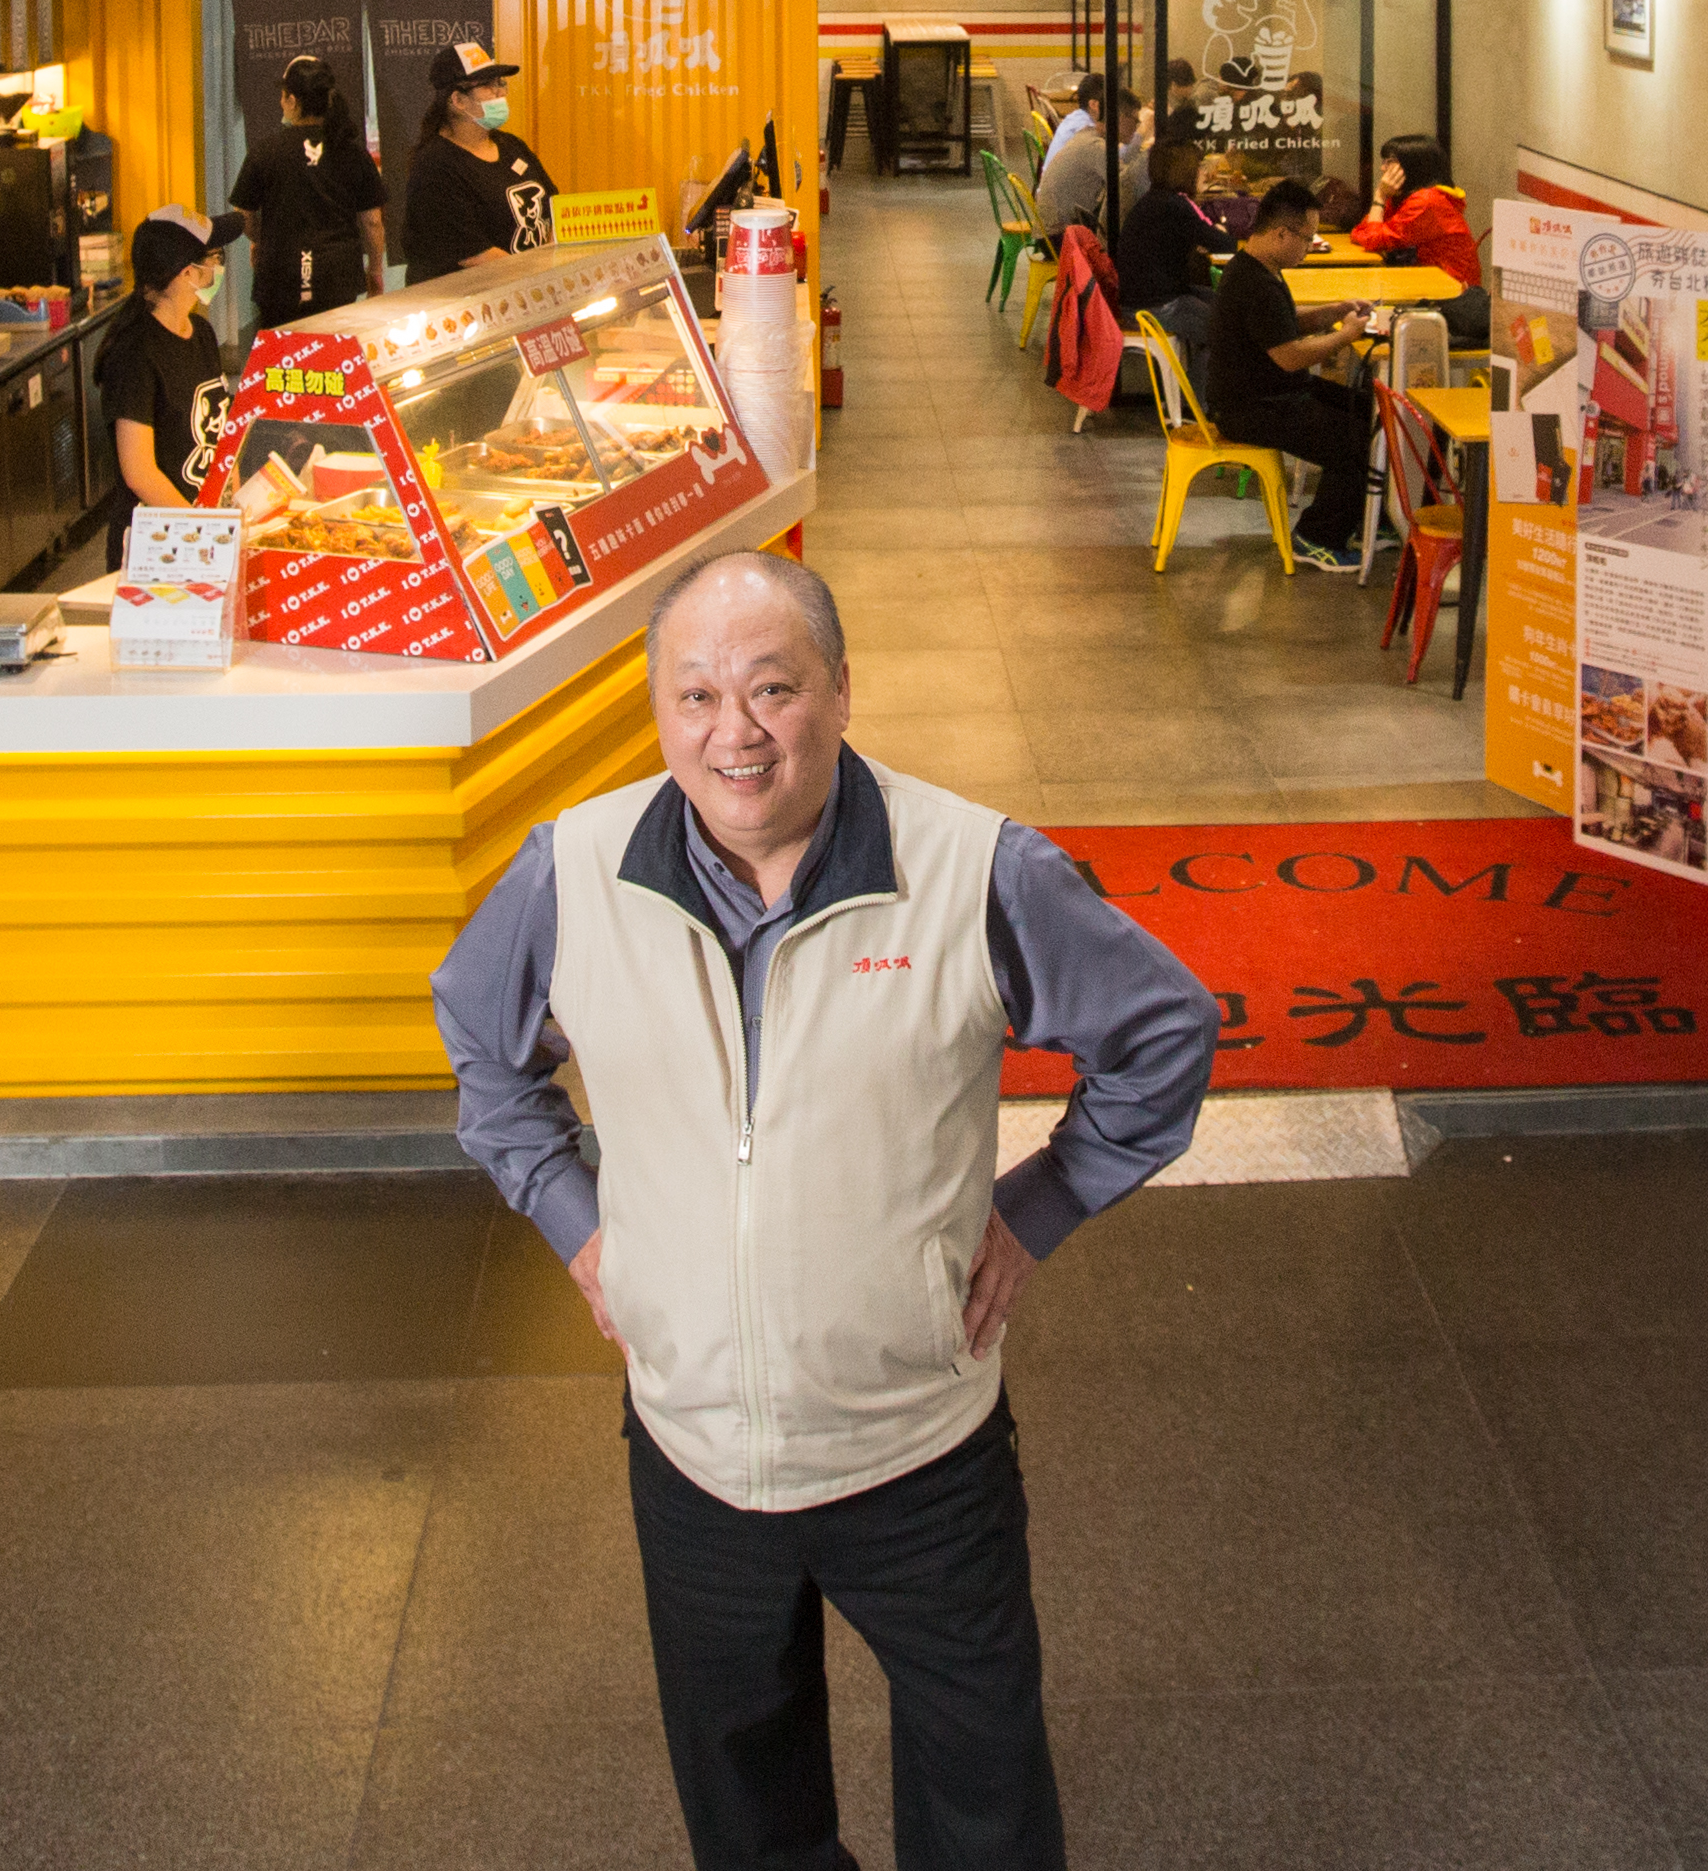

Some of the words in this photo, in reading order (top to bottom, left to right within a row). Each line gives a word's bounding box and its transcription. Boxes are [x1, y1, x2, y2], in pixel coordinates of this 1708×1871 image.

[593, 29, 722, 75] 頂呱呱
[672, 82, 739, 97] Chicken
[1195, 93, 1325, 133] 頂呱呱
[1227, 137, 1269, 150] Fried
[1275, 136, 1342, 150] Chicken
[264, 367, 346, 397] 高溫勿碰
[1077, 851, 1634, 918] LCOME
[852, 955, 912, 974] 頂呱呱
